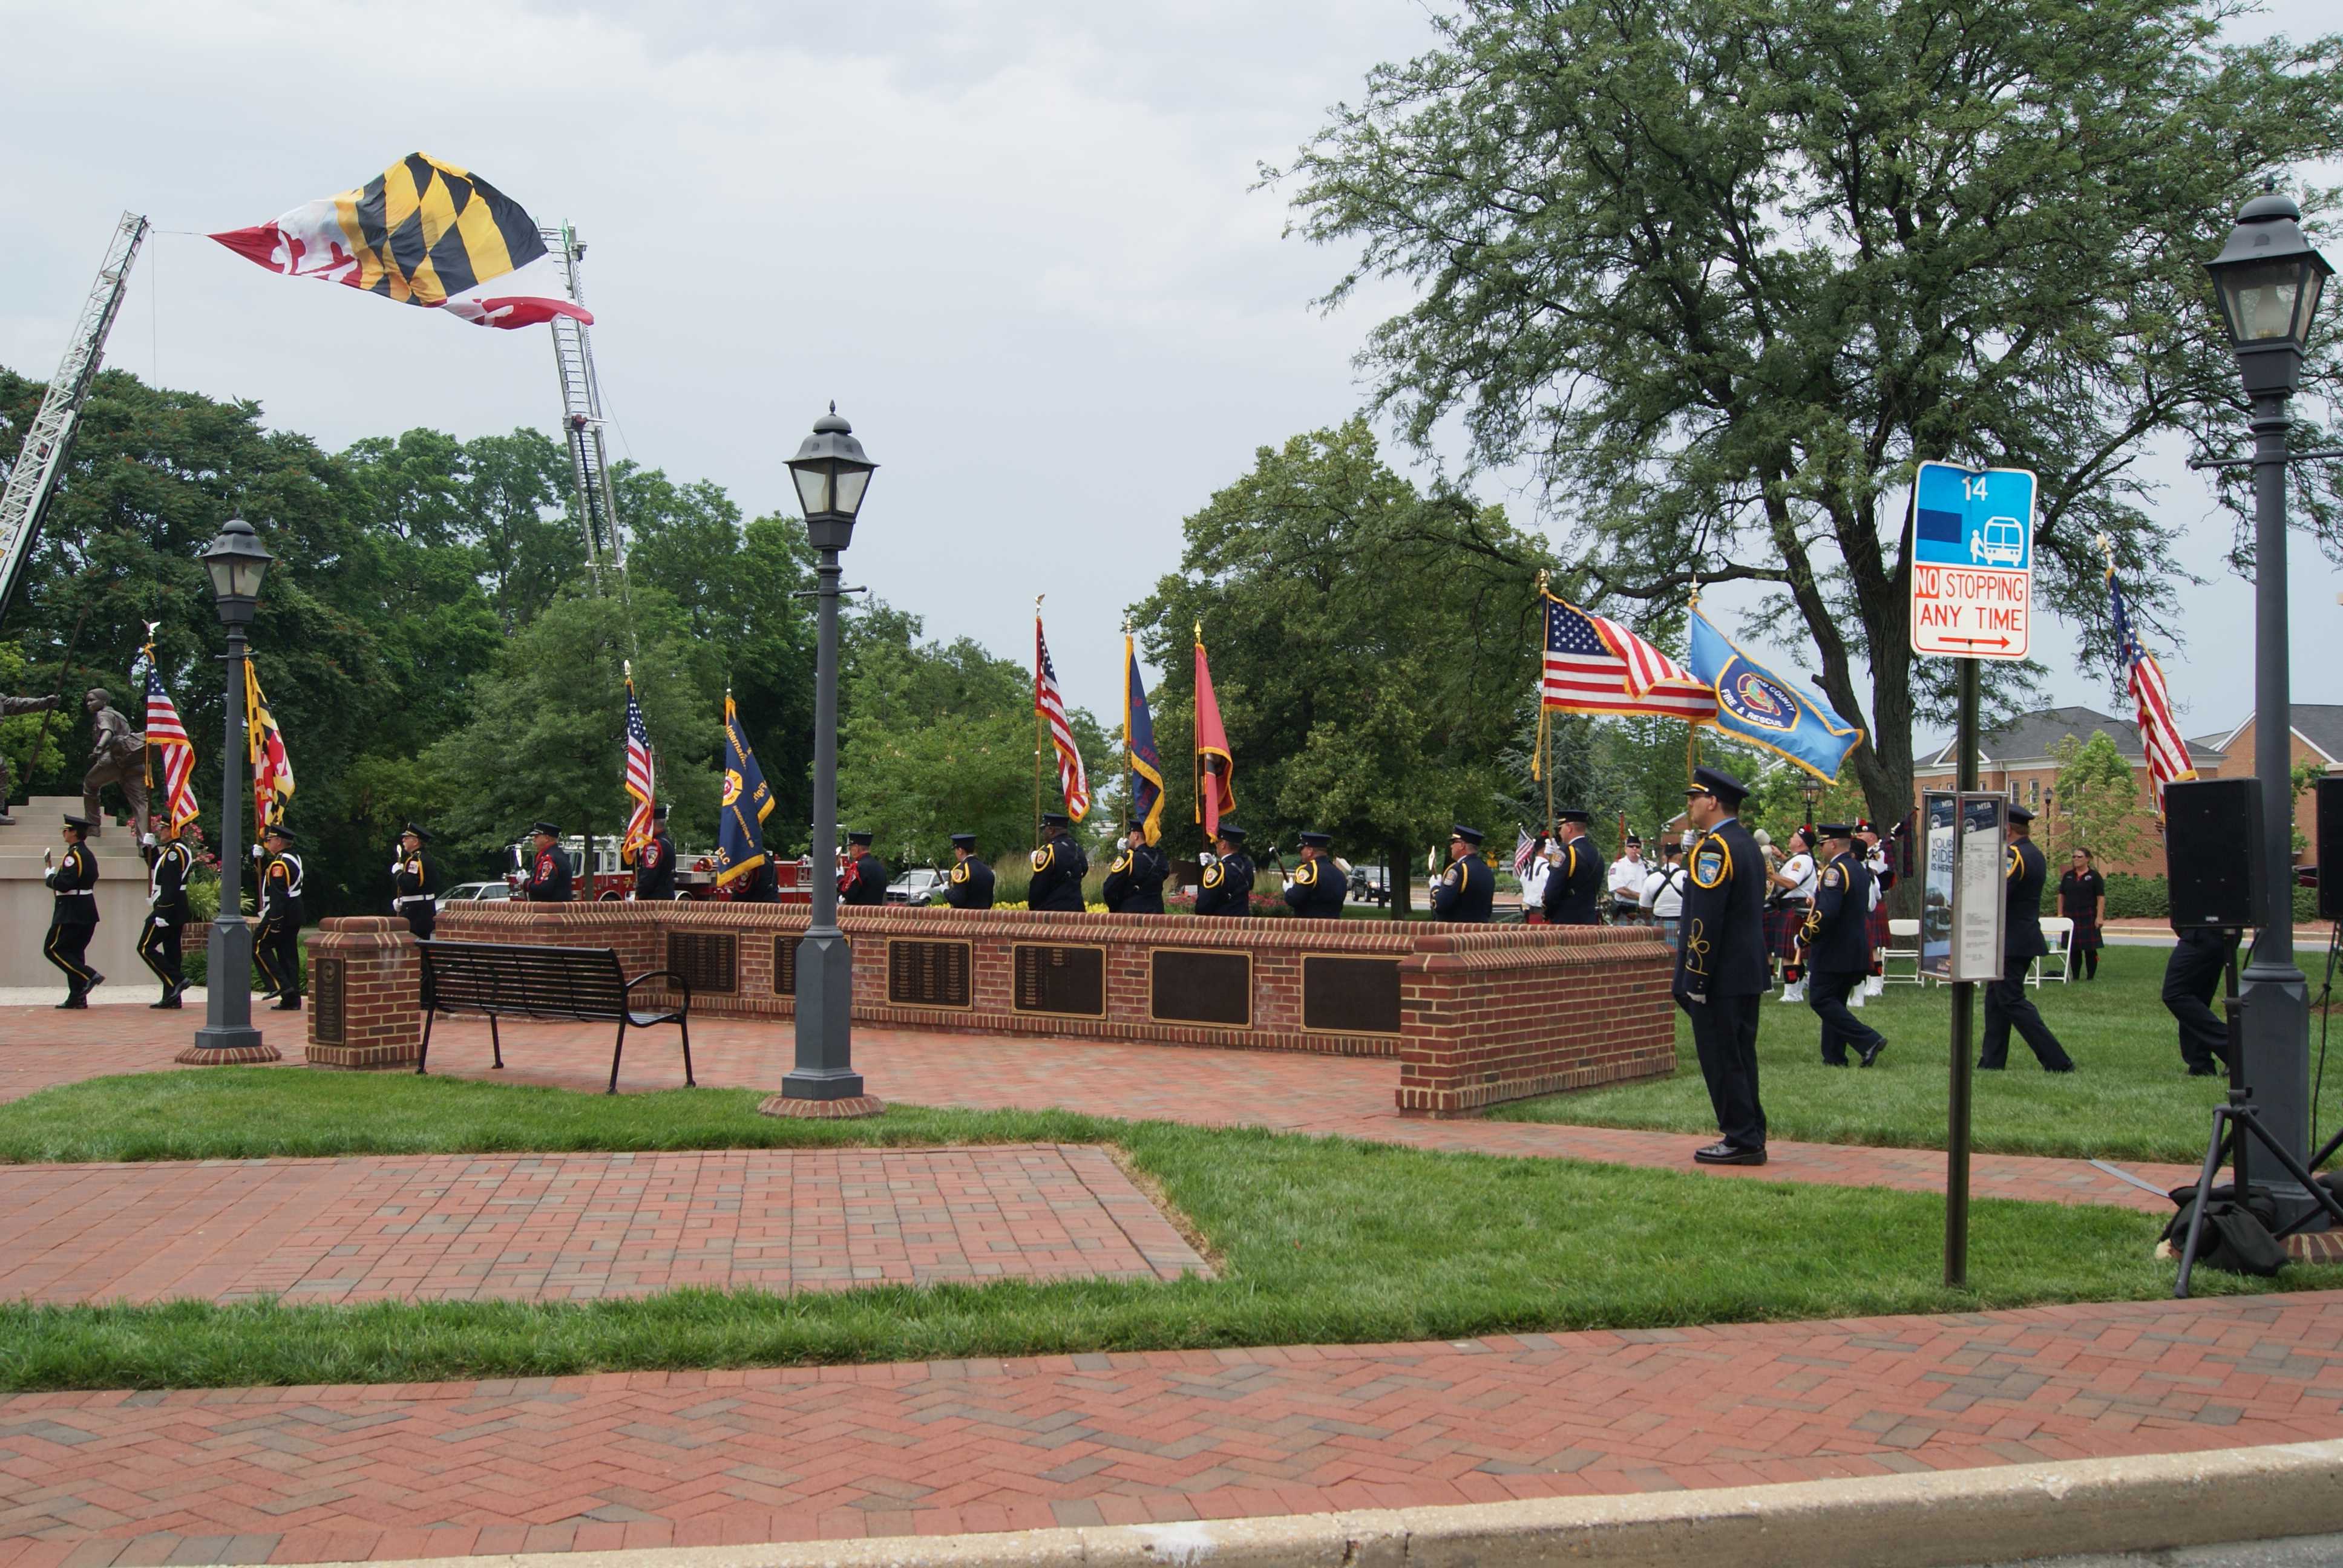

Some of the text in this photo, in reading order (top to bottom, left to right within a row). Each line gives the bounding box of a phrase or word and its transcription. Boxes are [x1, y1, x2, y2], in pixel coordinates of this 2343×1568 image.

[1961, 476, 1988, 501] 14
[1915, 568, 2023, 601] NO STOPPING
[1920, 603, 2022, 631] ANY TIME
[1720, 688, 1737, 707] FIRE
[1736, 707, 1745, 715] &
[1769, 686, 1796, 713] COUNTY
[1932, 849, 1953, 863] RIDE
